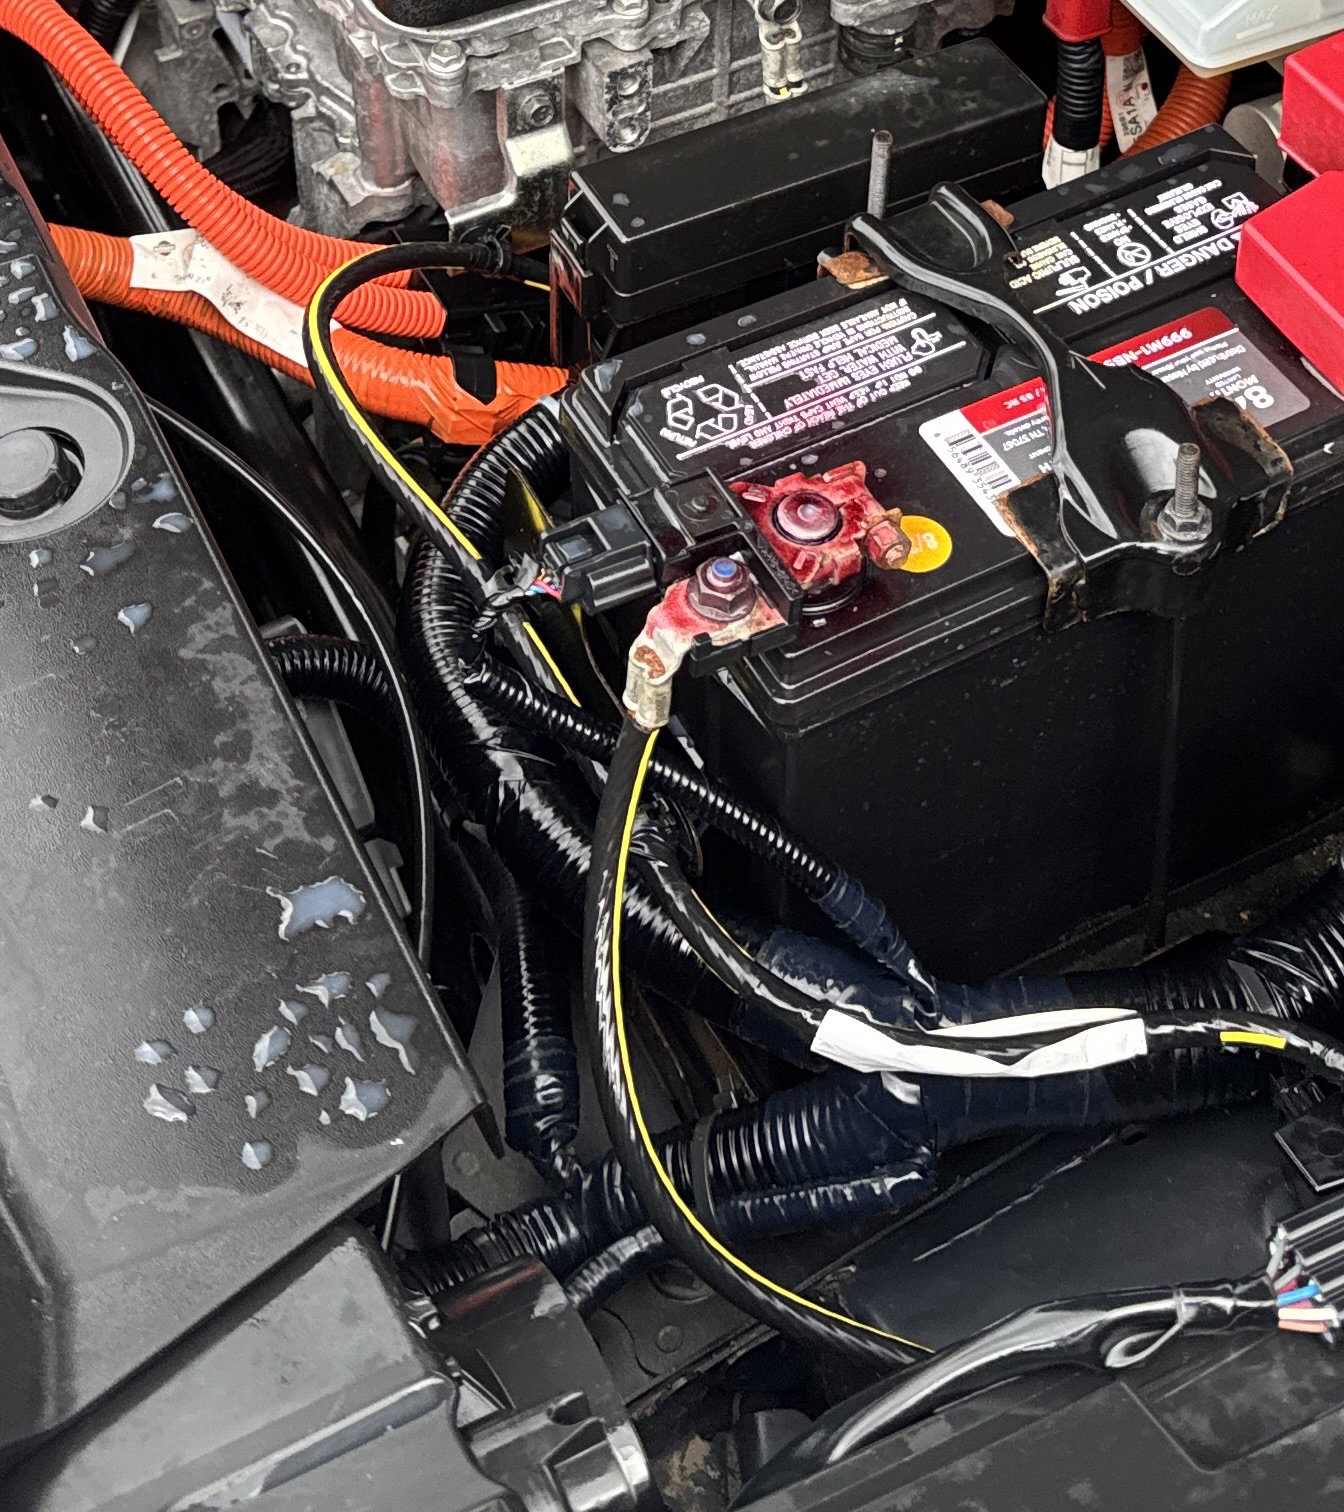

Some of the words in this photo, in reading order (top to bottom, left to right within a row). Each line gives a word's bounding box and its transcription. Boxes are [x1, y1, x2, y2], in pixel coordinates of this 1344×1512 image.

[1241, 3, 1279, 28] MAX
[1121, 95, 1143, 143] SA1A
[1153, 236, 1235, 278] DANGER
[1030, 254, 1081, 280] SULFURIC
[1007, 273, 1033, 290] ACID
[1065, 275, 1144, 315] POISON
[852, 334, 899, 357] MEDICAL
[876, 342, 906, 360] WITH
[826, 352, 854, 369] HELP
[877, 350, 914, 371] FLUSH
[1181, 361, 1197, 374] by
[816, 369, 839, 384] GET
[849, 364, 879, 382] EYES
[782, 375, 851, 410] IMMEDIATELY
[867, 386, 889, 403] OUT
[798, 403, 824, 418] CAPS
[752, 424, 773, 438] AND
[1027, 427, 1045, 439] TN
